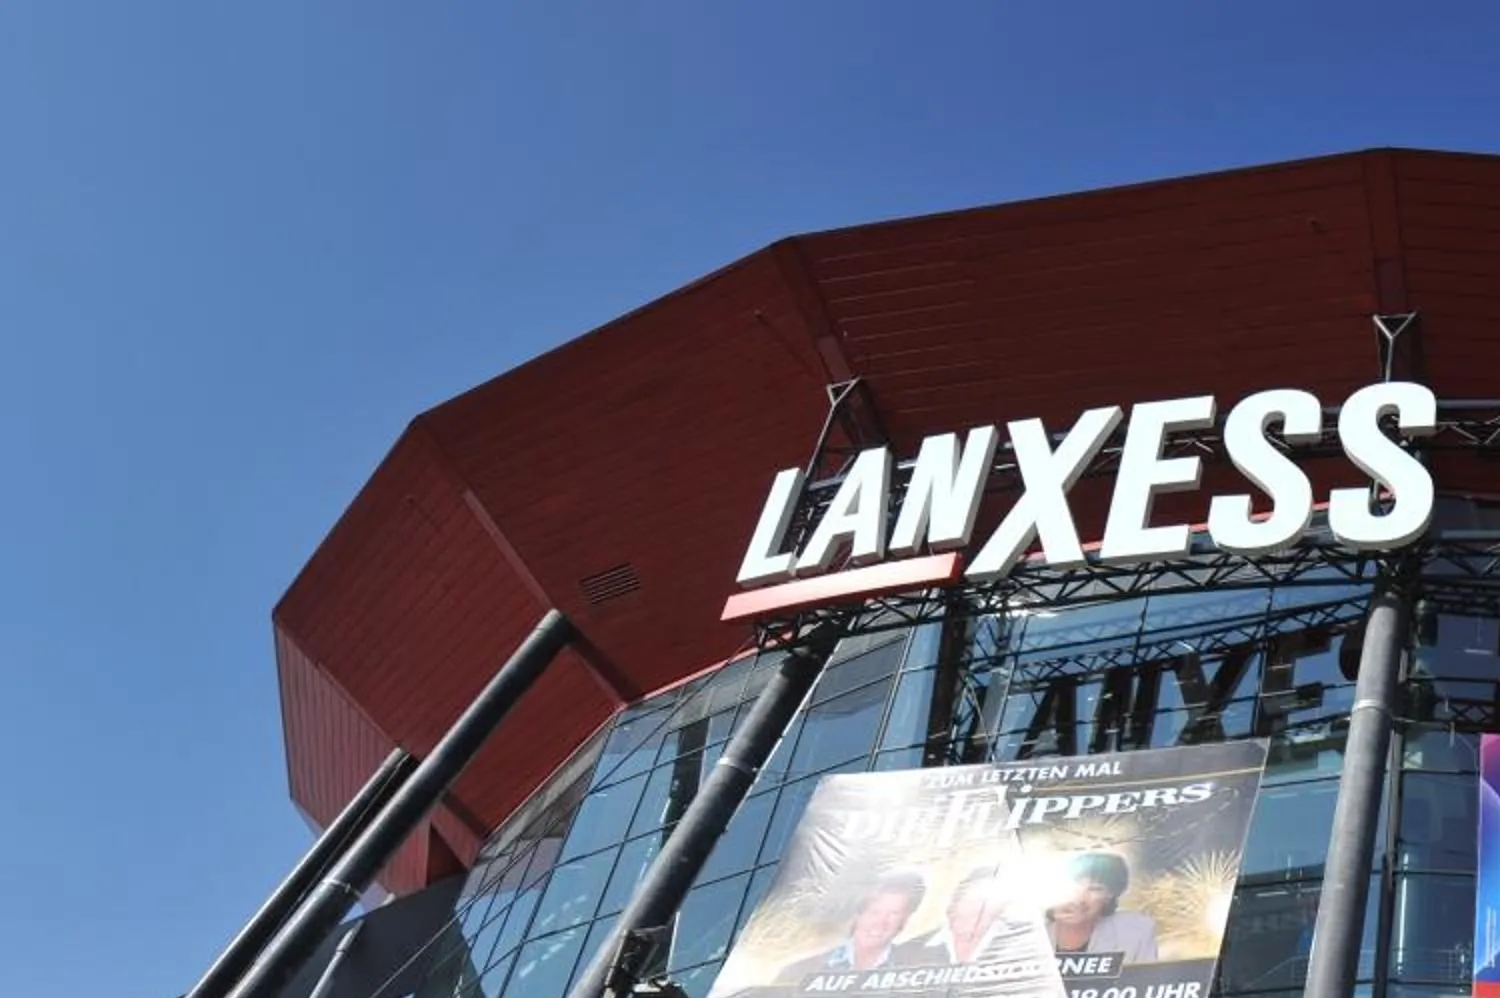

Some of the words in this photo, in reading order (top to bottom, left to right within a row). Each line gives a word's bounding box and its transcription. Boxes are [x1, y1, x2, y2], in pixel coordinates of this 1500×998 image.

[735, 381, 1437, 585] LANXESS
[981, 765, 1068, 784] LETZTEN
[1074, 760, 1123, 778] MAL
[804, 975, 859, 992] AUF
[862, 956, 1115, 989] ABSCHIEDNEE
